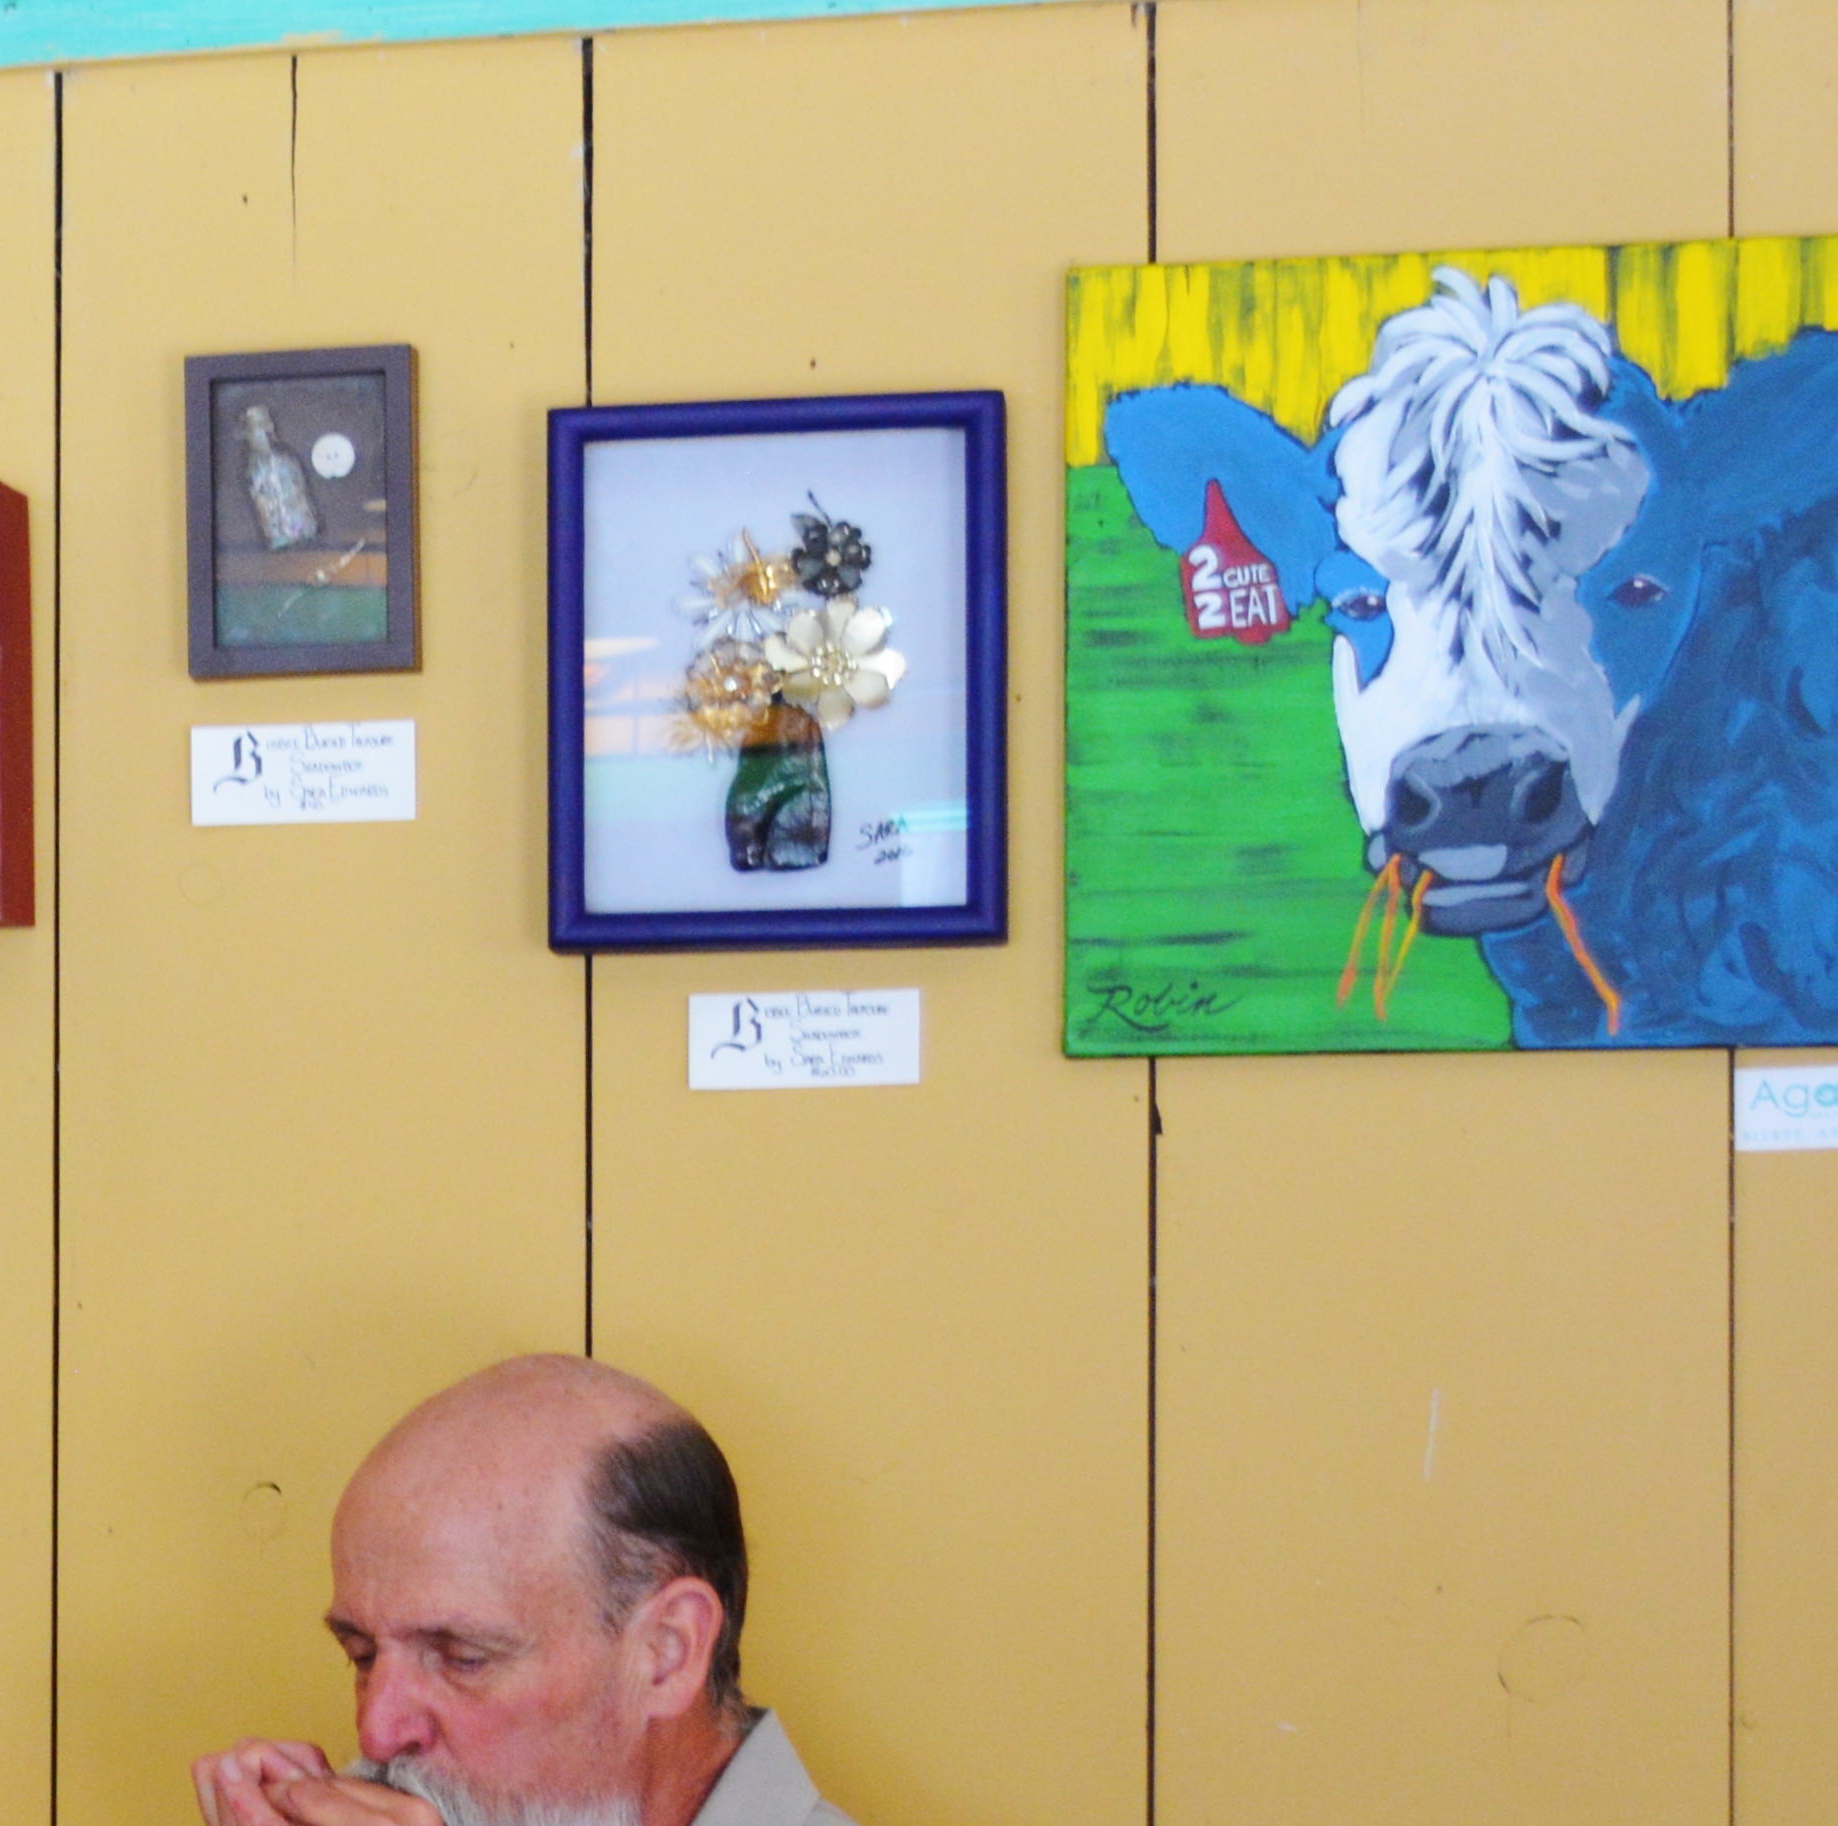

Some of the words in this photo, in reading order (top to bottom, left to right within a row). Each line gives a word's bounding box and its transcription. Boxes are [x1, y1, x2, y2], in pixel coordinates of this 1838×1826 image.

[1189, 545, 1223, 592] 2
[1223, 563, 1271, 588] CUTE
[1193, 592, 1226, 630] 2
[1229, 583, 1278, 628] EAT
